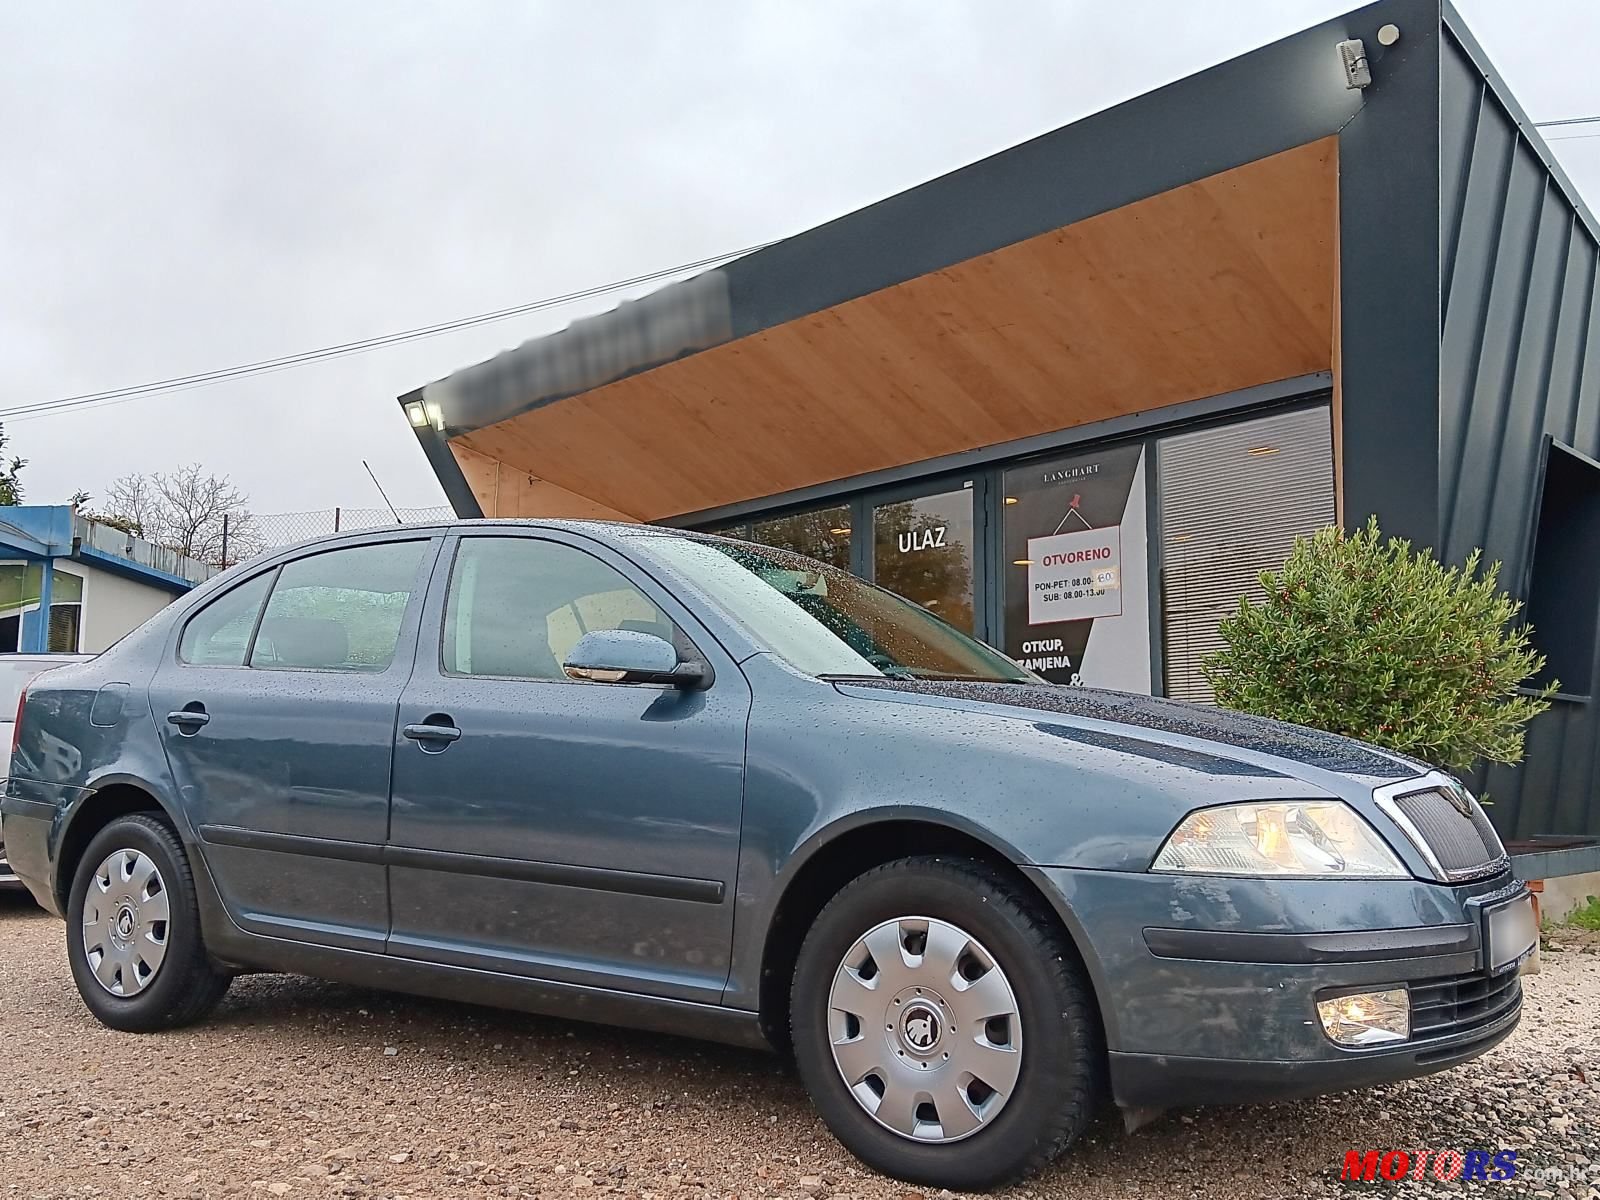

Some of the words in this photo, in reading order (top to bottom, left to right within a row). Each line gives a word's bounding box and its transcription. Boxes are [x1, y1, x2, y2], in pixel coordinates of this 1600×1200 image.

[1043, 464, 1100, 483] LANGHART
[898, 526, 946, 553] ULAZ
[1042, 547, 1111, 567] OTVORENO
[1034, 579, 1071, 591] PON-PET:
[1043, 592, 1061, 602] SUB:
[1022, 638, 1064, 653] OTKUP,
